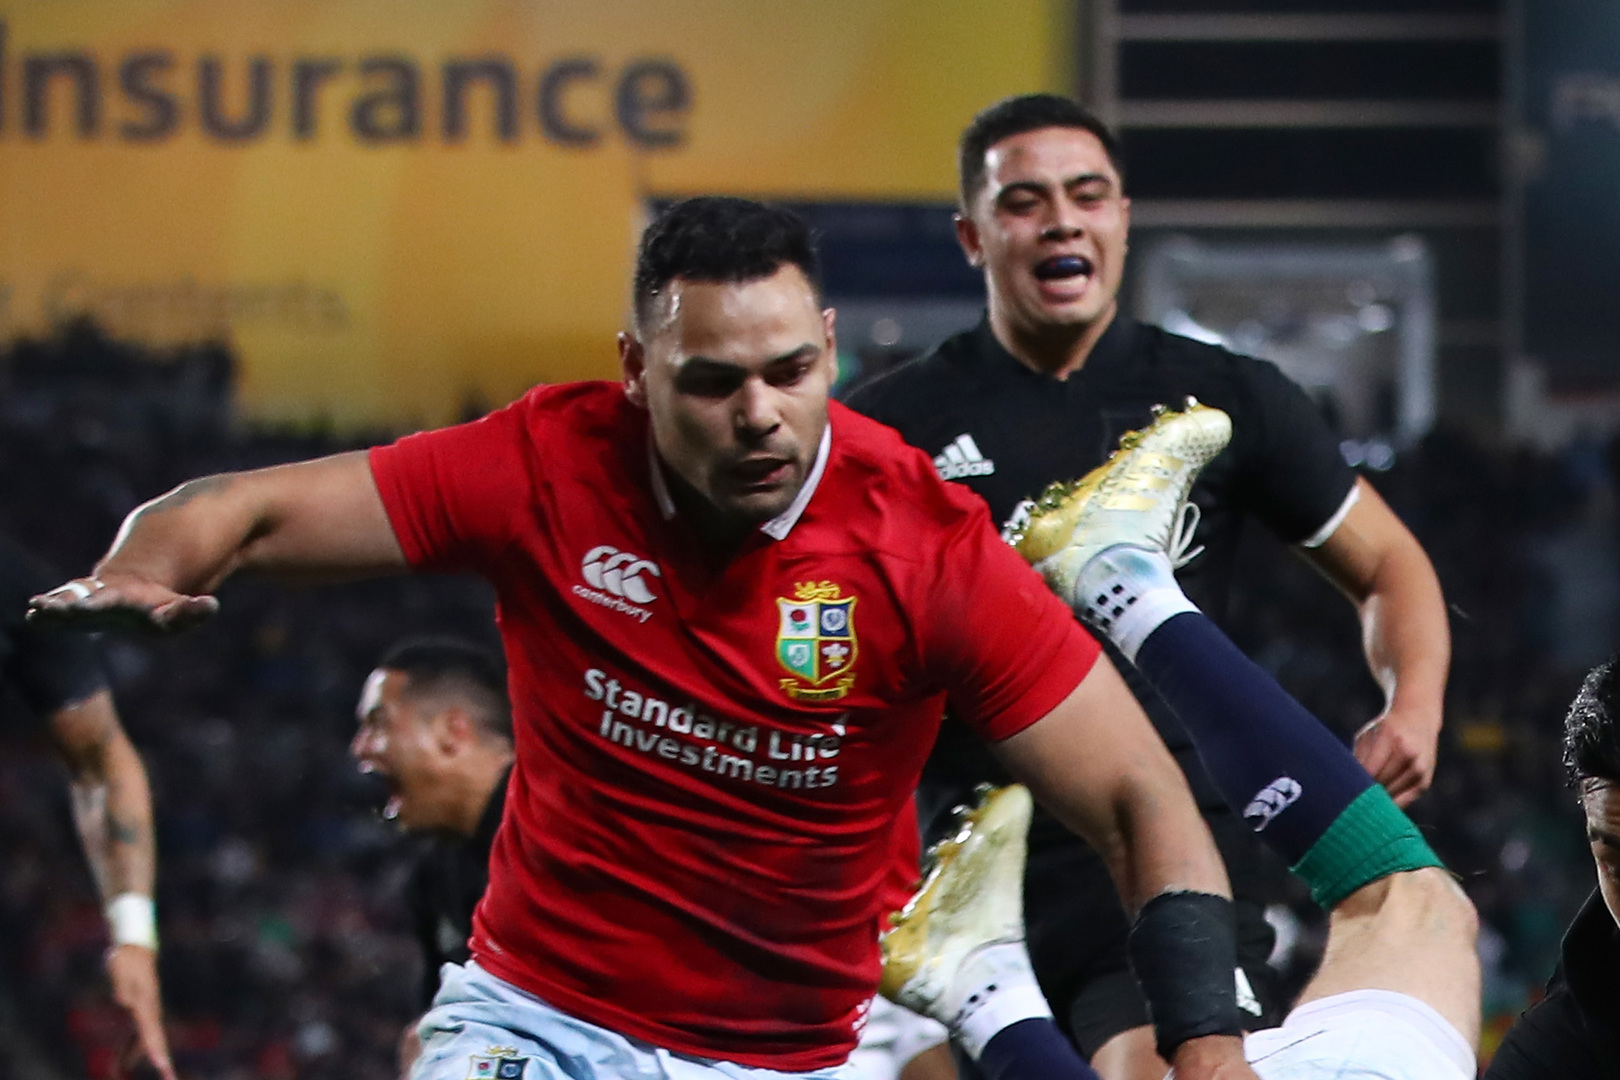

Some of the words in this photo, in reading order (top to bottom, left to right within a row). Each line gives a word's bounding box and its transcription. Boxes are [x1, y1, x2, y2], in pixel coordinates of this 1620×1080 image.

[0, 20, 693, 149] nsurance
[936, 458, 995, 481] didas
[571, 584, 654, 624] canterbury
[584, 668, 759, 754] Standard
[769, 731, 841, 763] Life
[600, 710, 840, 790] Investments
